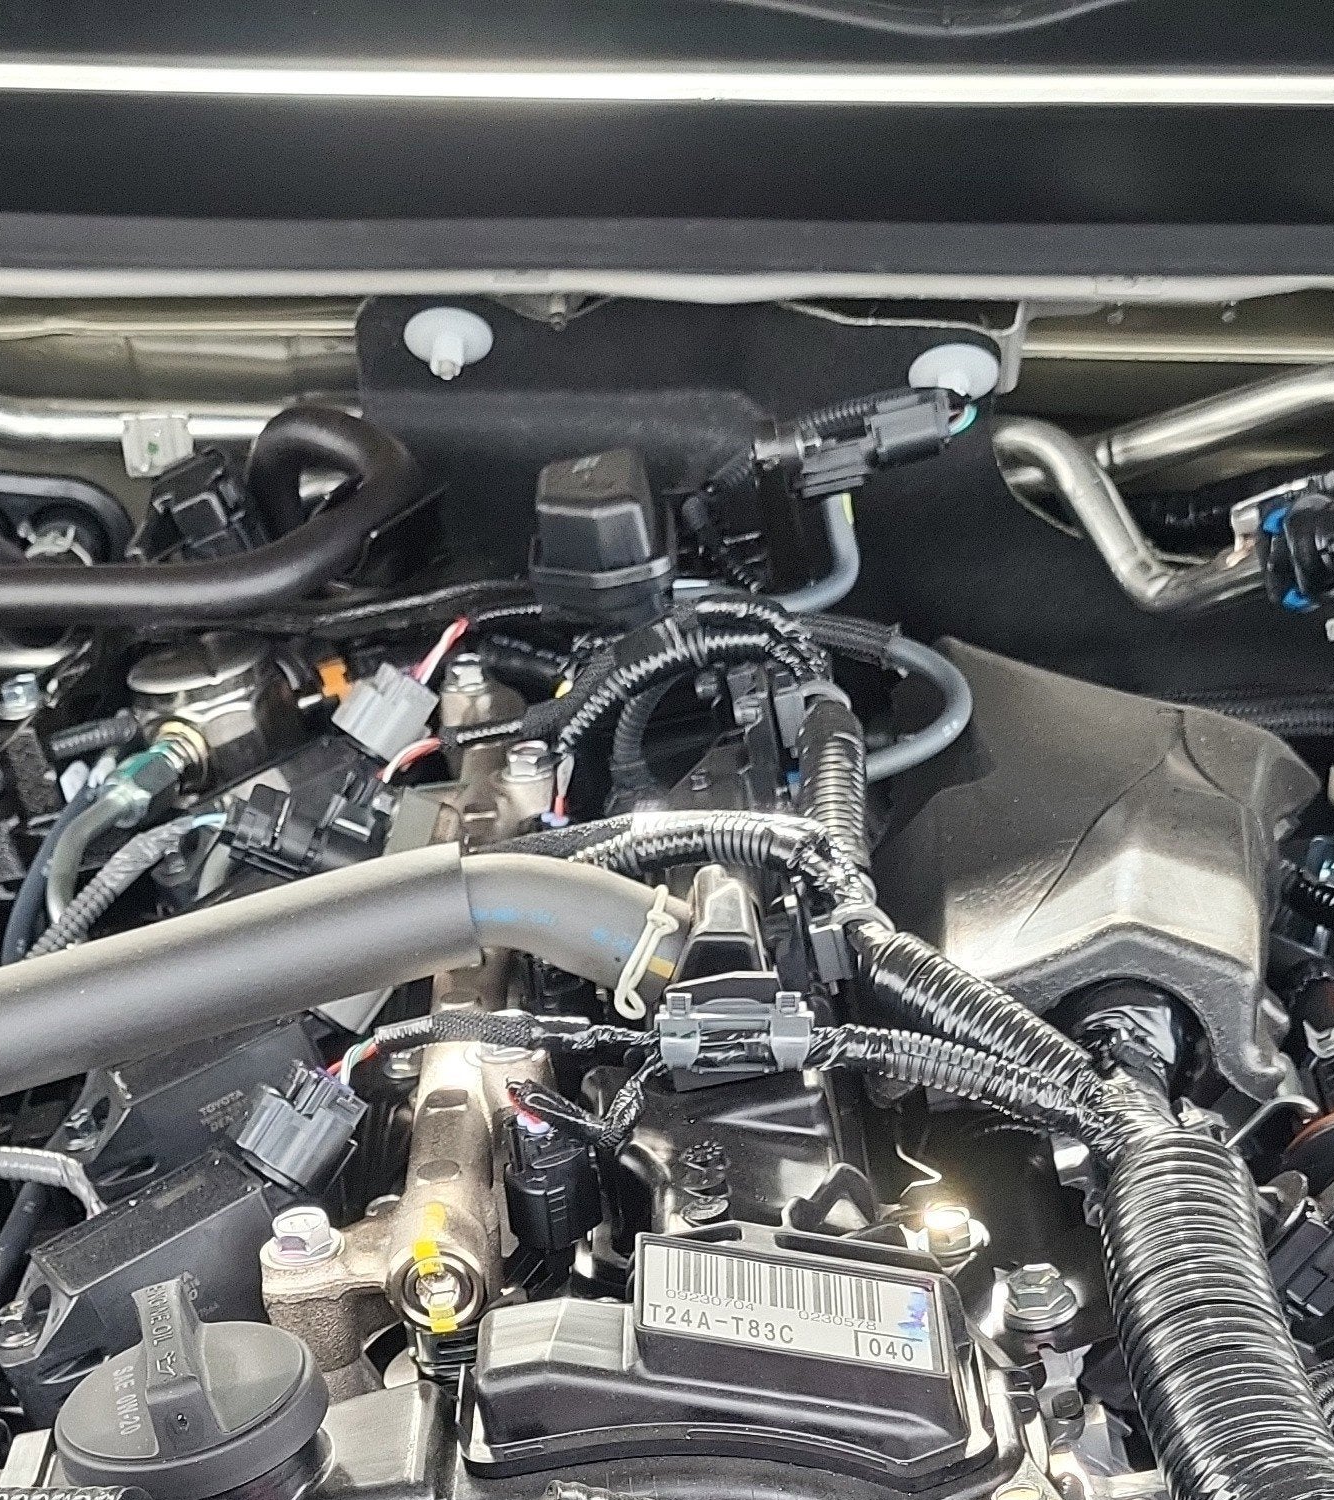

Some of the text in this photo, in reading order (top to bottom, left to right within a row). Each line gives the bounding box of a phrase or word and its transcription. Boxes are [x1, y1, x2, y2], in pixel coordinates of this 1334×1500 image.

[146, 1284, 174, 1347] ENGINE OIL
[665, 1288, 755, 1312] 09230704
[648, 1302, 795, 1345] T24A-T83C
[797, 1309, 878, 1332] 0230578
[868, 1337, 915, 1363] 040
[112, 1365, 142, 1436] SAE 0W-20
